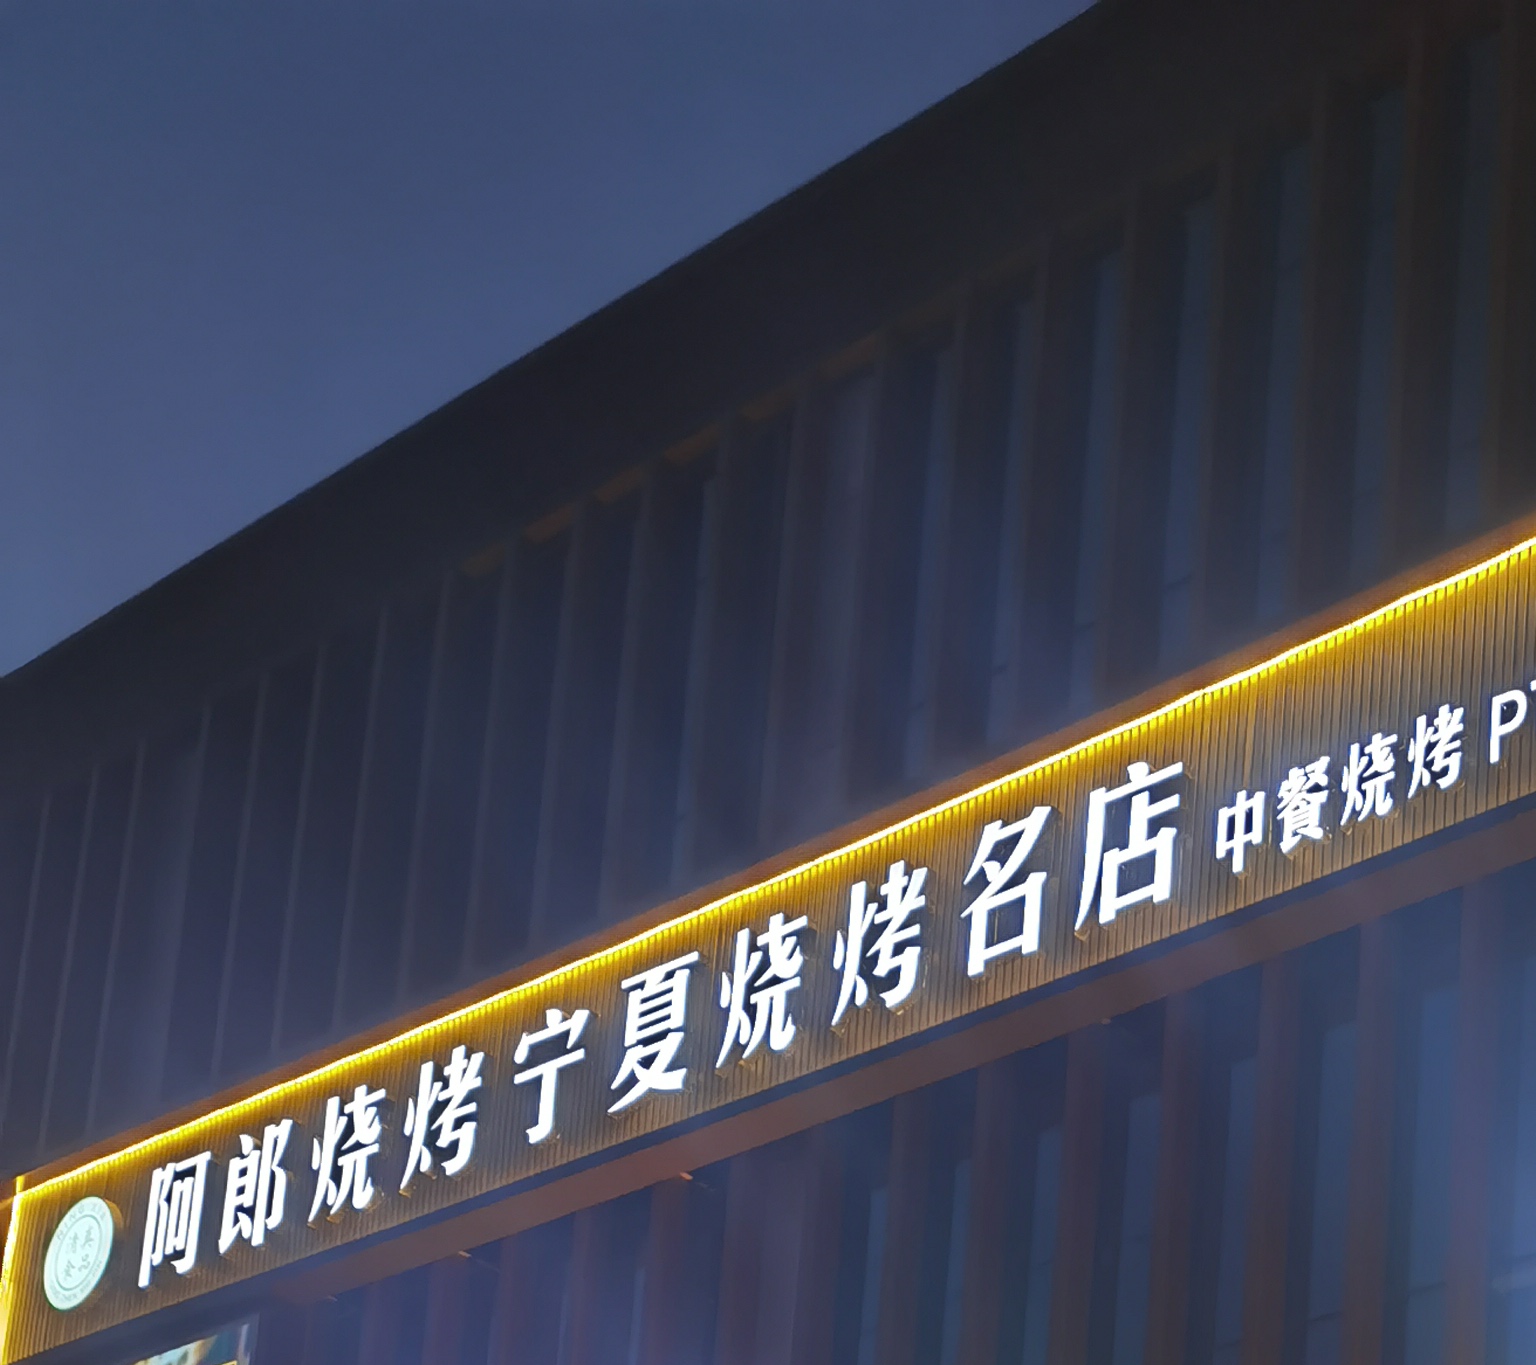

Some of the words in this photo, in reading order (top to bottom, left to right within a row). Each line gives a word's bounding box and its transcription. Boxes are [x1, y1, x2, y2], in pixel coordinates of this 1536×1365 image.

[137, 761, 1184, 1288] 阿郎烧烤宁夏烧烤名店
[1215, 704, 1465, 873] 中餐烧烤
